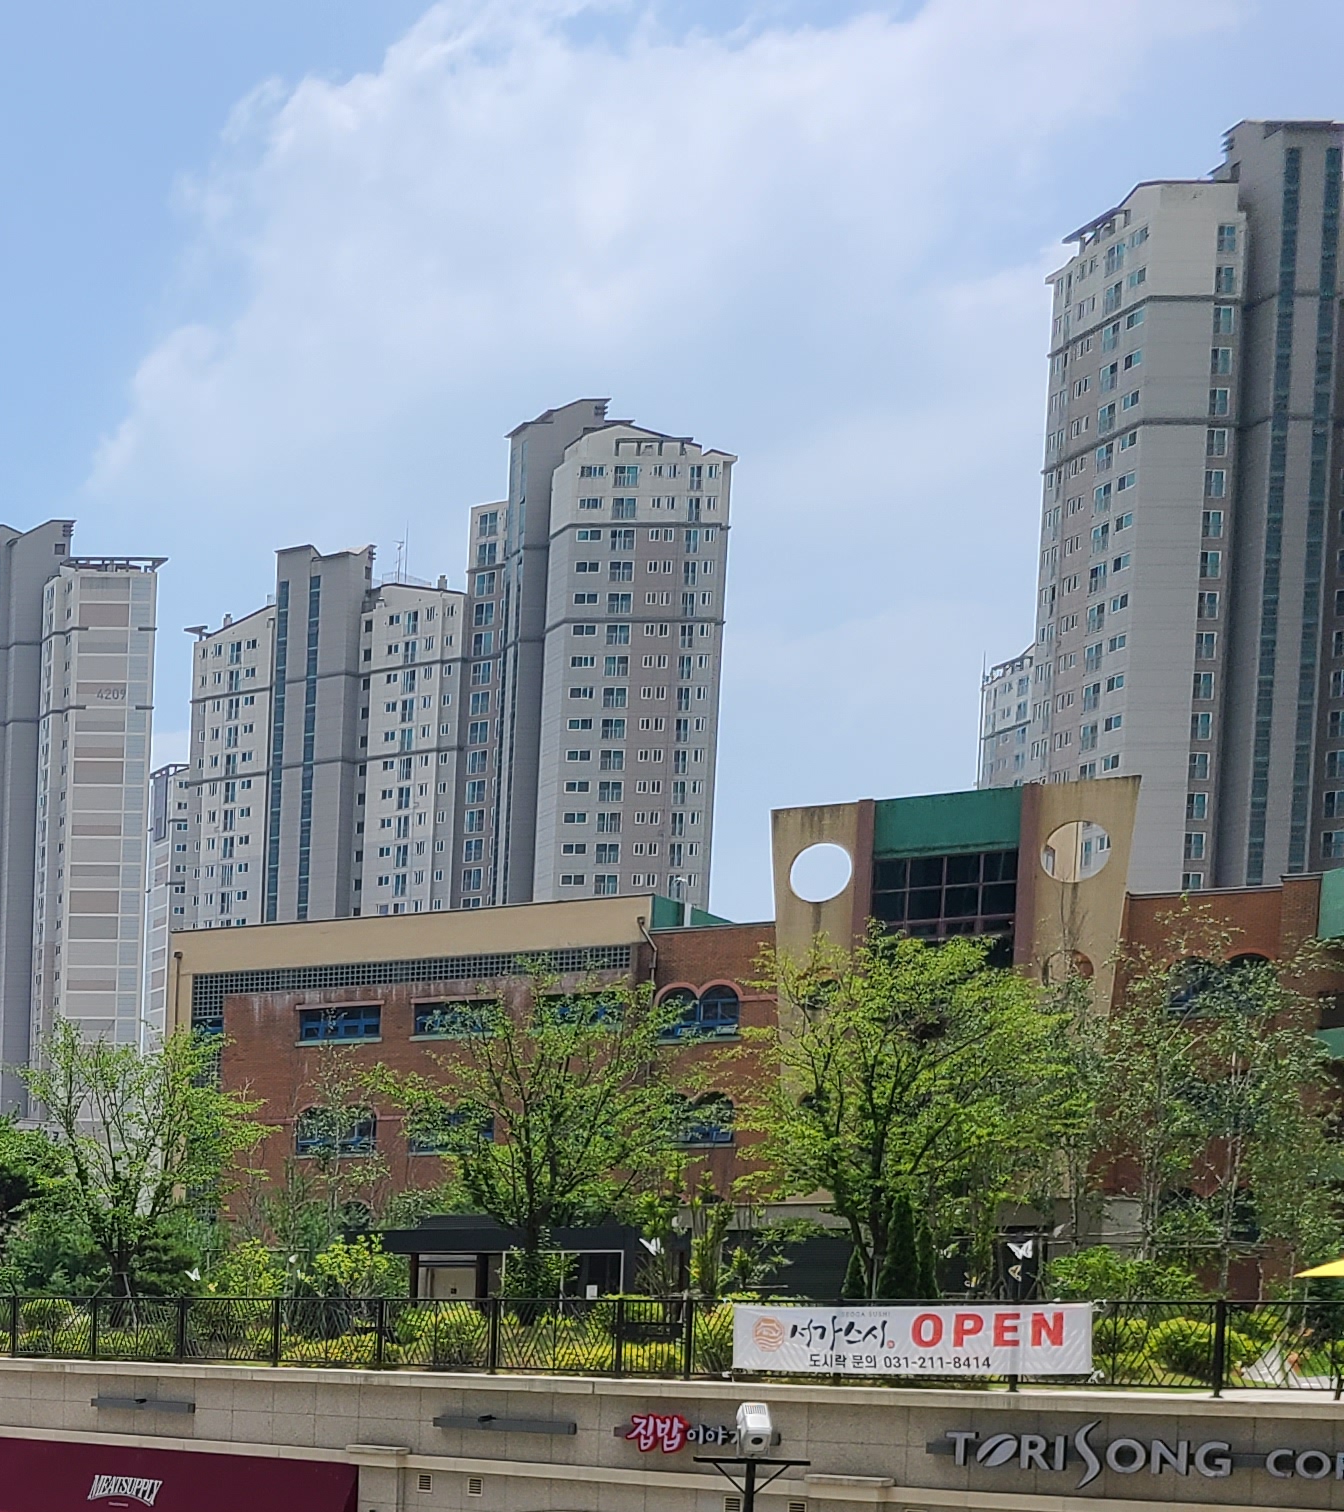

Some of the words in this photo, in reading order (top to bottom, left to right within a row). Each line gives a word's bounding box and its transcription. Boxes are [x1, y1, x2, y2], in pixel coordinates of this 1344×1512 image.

[96, 688, 127, 700] 4209
[912, 1312, 1065, 1348] OPEN
[808, 1353, 847, 1369] 도시락
[852, 1354, 878, 1369] 문의
[883, 1356, 992, 1370] 031-211-8414
[87, 1474, 163, 1506] MEATSUPPLY
